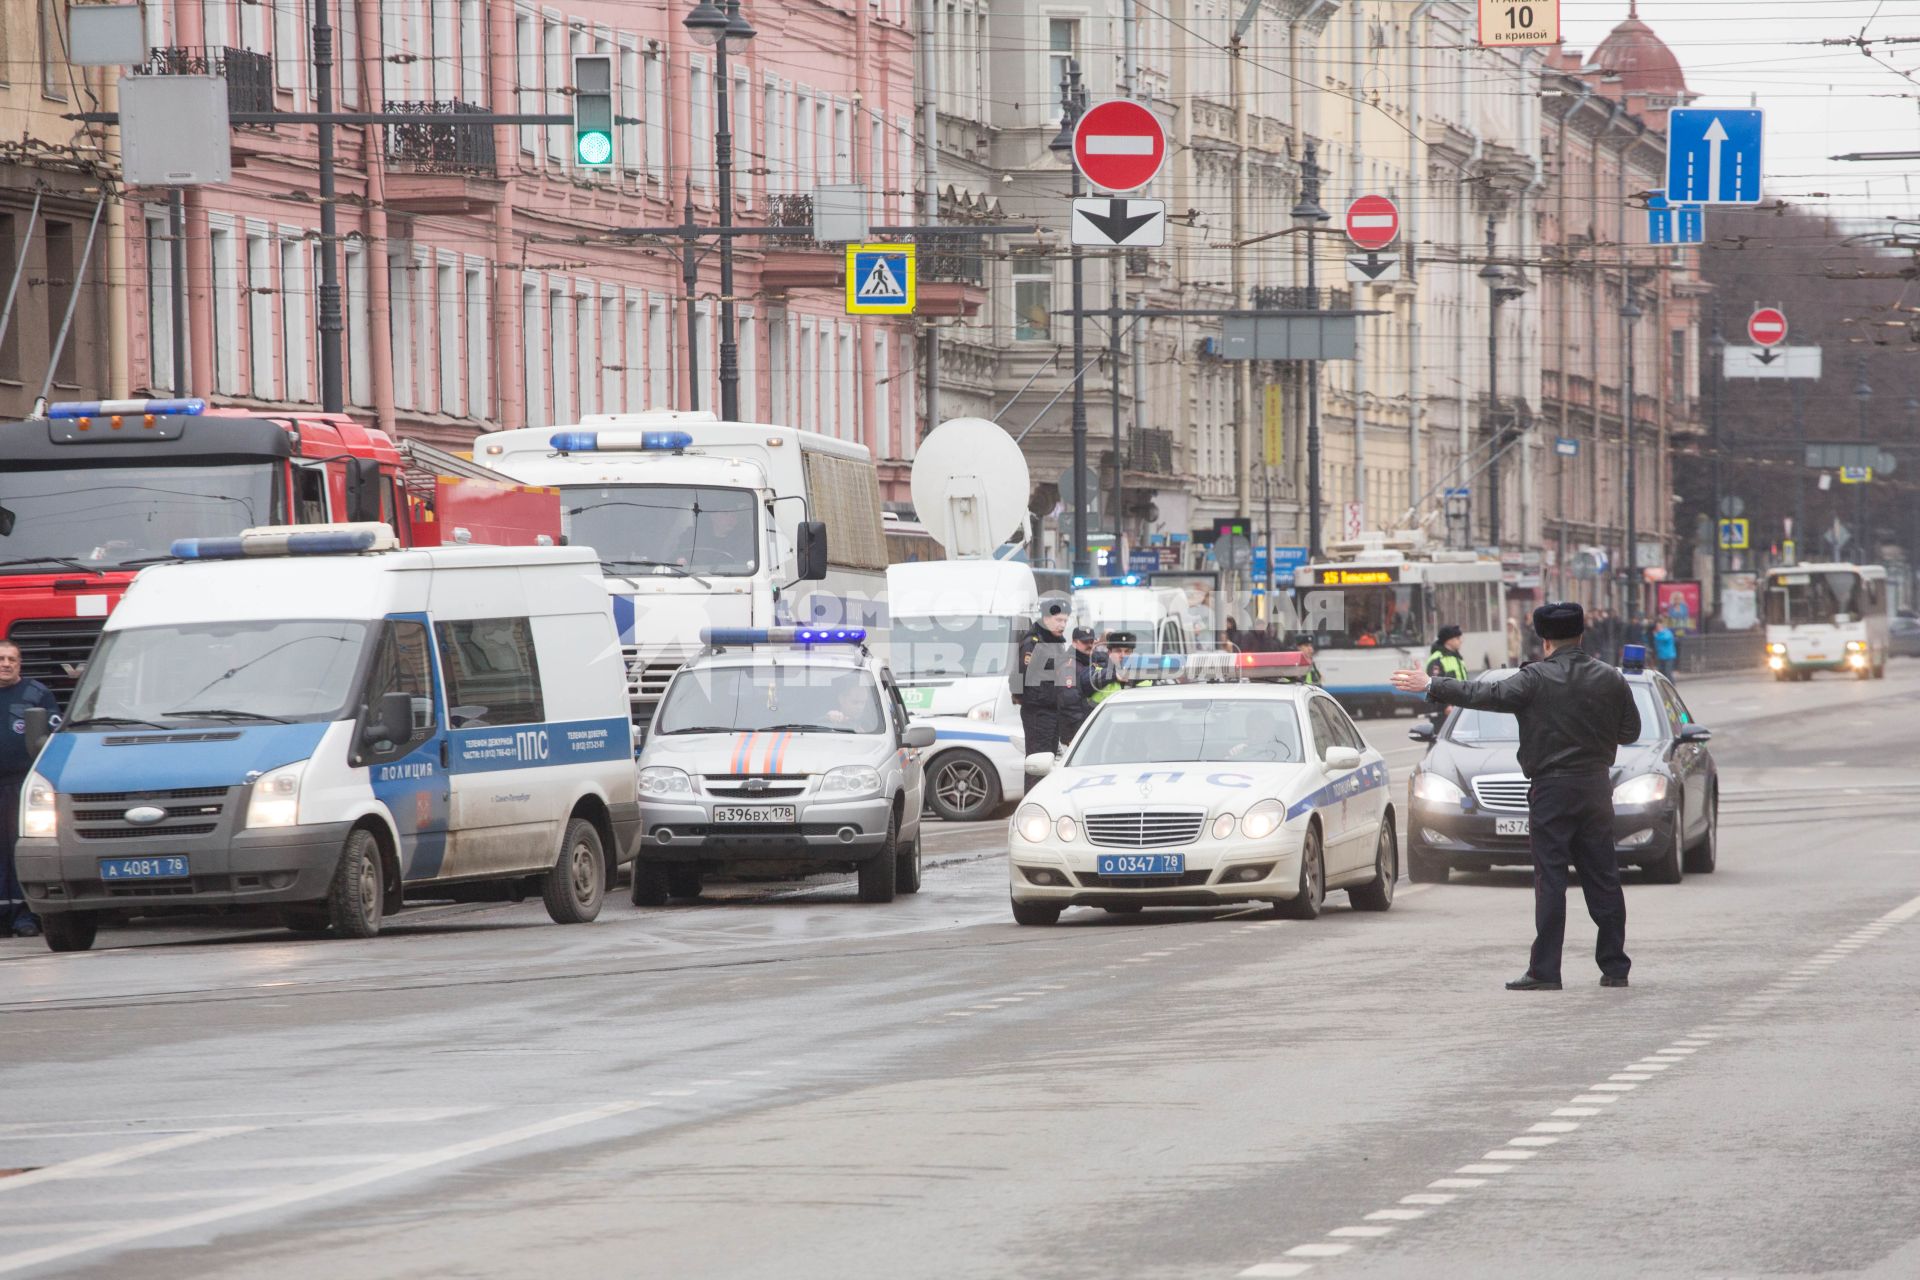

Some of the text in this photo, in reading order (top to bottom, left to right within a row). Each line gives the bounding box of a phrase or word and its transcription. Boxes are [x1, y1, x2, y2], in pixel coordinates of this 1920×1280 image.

[1505, 5, 1534, 29] 10
[1505, 29, 1548, 42] кривой
[516, 730, 549, 761] ППС
[380, 762, 433, 781] ПОЛИЦИЯ
[1062, 771, 1255, 794] ДПС
[718, 807, 791, 821] В396ВХ 178
[109, 858, 183, 876] А 4081 78
[1118, 857, 1155, 871] 0347
[1164, 855, 1178, 867] 78
